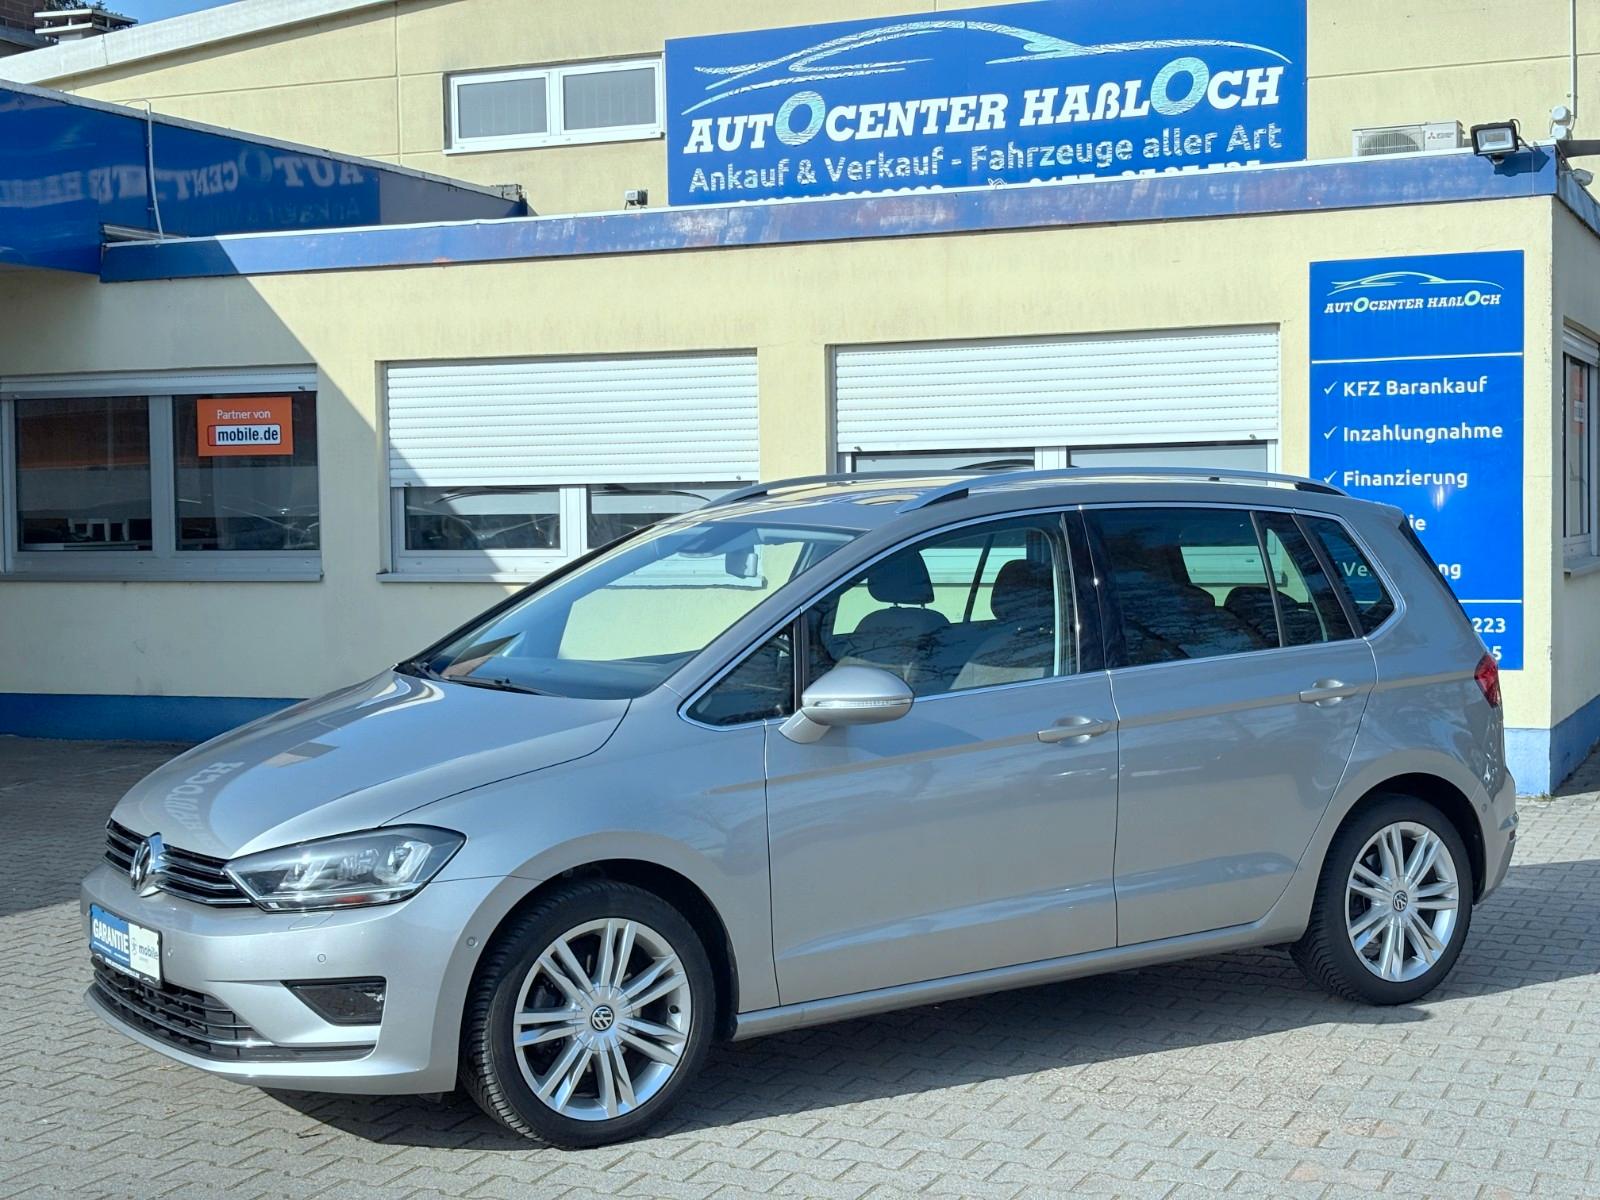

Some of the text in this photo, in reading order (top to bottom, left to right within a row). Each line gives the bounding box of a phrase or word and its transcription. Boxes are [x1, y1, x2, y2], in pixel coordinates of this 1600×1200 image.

[684, 90, 1009, 154] AUTOCENTER
[689, 158, 790, 193] Ankauf
[797, 159, 817, 185] &
[824, 146, 945, 183] Verkauf
[971, 139, 1133, 171] Fahrzeuge
[1143, 128, 1218, 158] aller
[1226, 122, 1283, 152] Art
[1324, 297, 1424, 314] AUTOCENTER
[1343, 376, 1488, 397] KFZ Barankauf
[217, 409, 271, 420] Partner von
[217, 427, 278, 442] mobile.de
[1343, 422, 1503, 444] Inzahlungnahme
[1343, 469, 1468, 488] Finanzierung
[93, 918, 130, 955] GARANTIE
